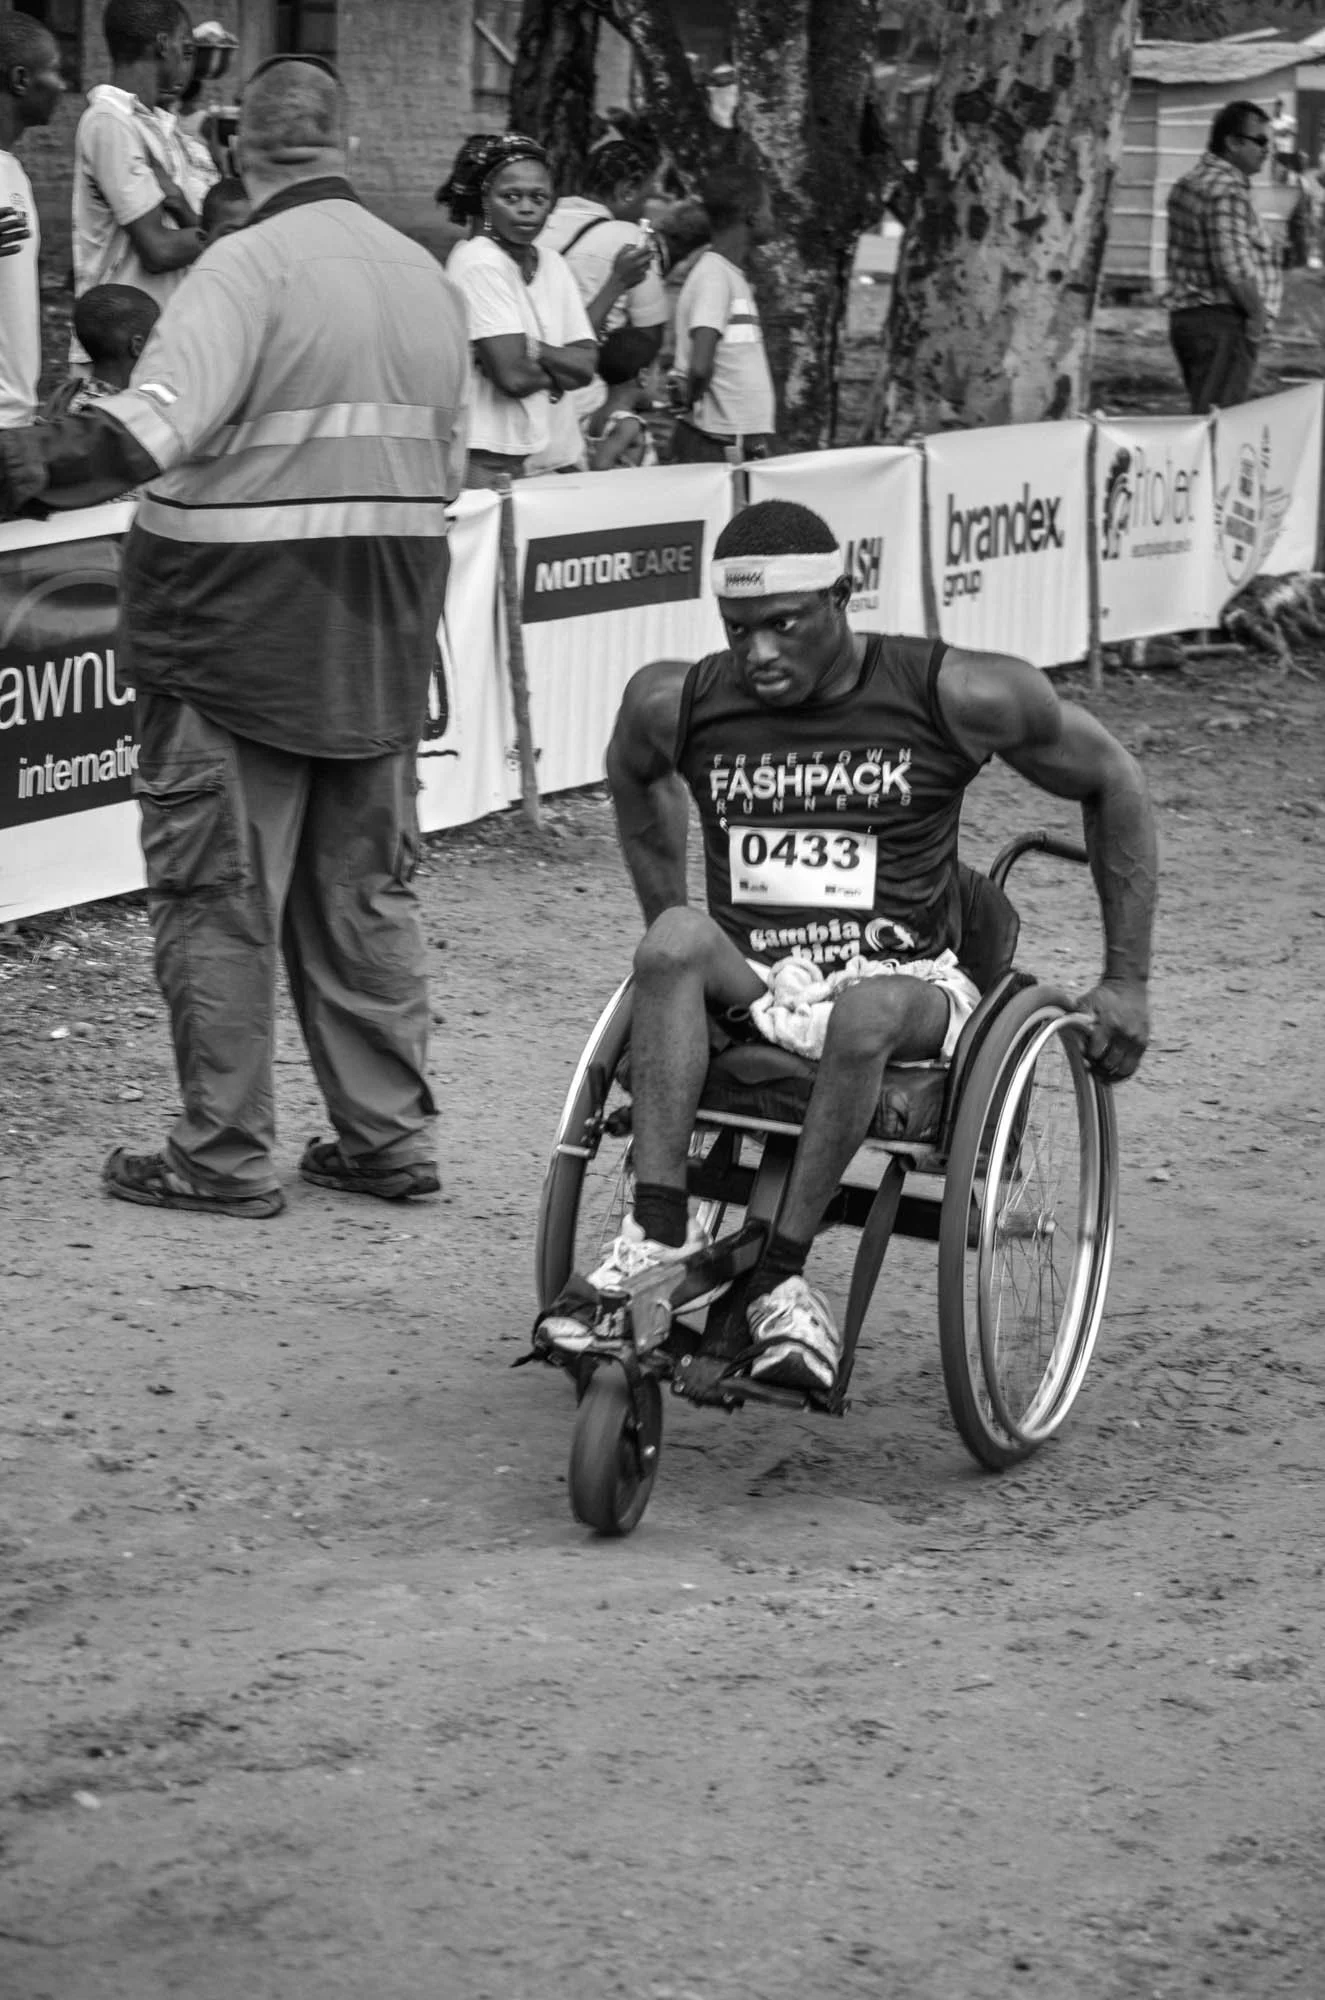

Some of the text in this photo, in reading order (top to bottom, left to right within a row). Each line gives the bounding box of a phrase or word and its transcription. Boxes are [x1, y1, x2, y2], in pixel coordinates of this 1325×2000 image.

[945, 482, 1064, 566] brandex
[534, 545, 693, 593] MOTORCARE
[943, 569, 981, 606] group
[713, 748, 911, 768] FREETOWN
[710, 761, 912, 800] FASHPACK
[716, 794, 911, 815] RUNNERS
[741, 833, 861, 869] 0433
[750, 918, 860, 952] gambia
[791, 940, 859, 963] bird
